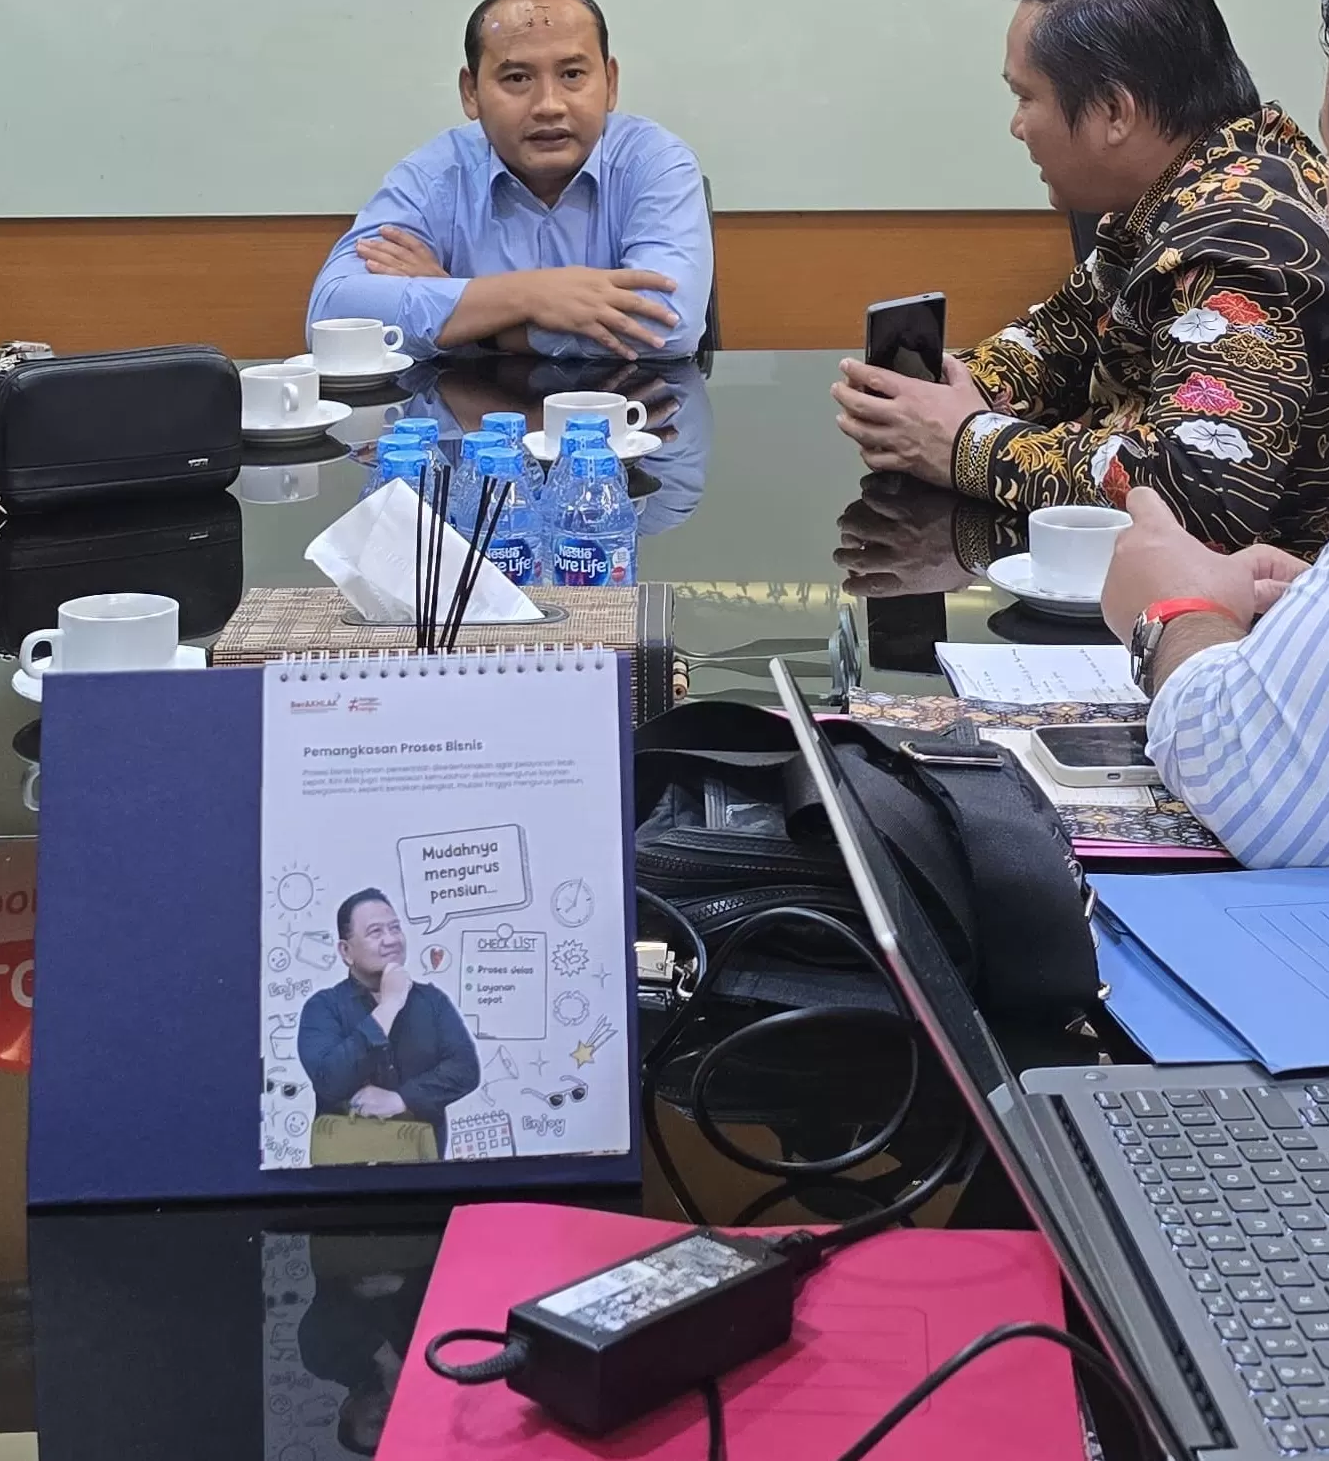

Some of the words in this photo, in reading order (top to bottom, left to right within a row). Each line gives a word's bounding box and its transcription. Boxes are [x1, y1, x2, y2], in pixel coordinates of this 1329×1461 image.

[509, 557, 532, 577] Life
[554, 555, 579, 572] Pure
[581, 558, 606, 578] Life
[303, 744, 398, 758] Pemangkasan
[401, 742, 442, 753] Proses
[445, 739, 483, 752] Bisnis
[422, 840, 499, 862] Mudahnya
[424, 860, 500, 883] mengurus
[478, 938, 510, 949] CHECK
[514, 936, 538, 949] LIST
[478, 965, 507, 974] Proses
[268, 977, 313, 1001] Enjoy
[477, 983, 515, 994] Layanan
[477, 995, 503, 1006] cepat
[522, 1113, 566, 1138] Enjoy
